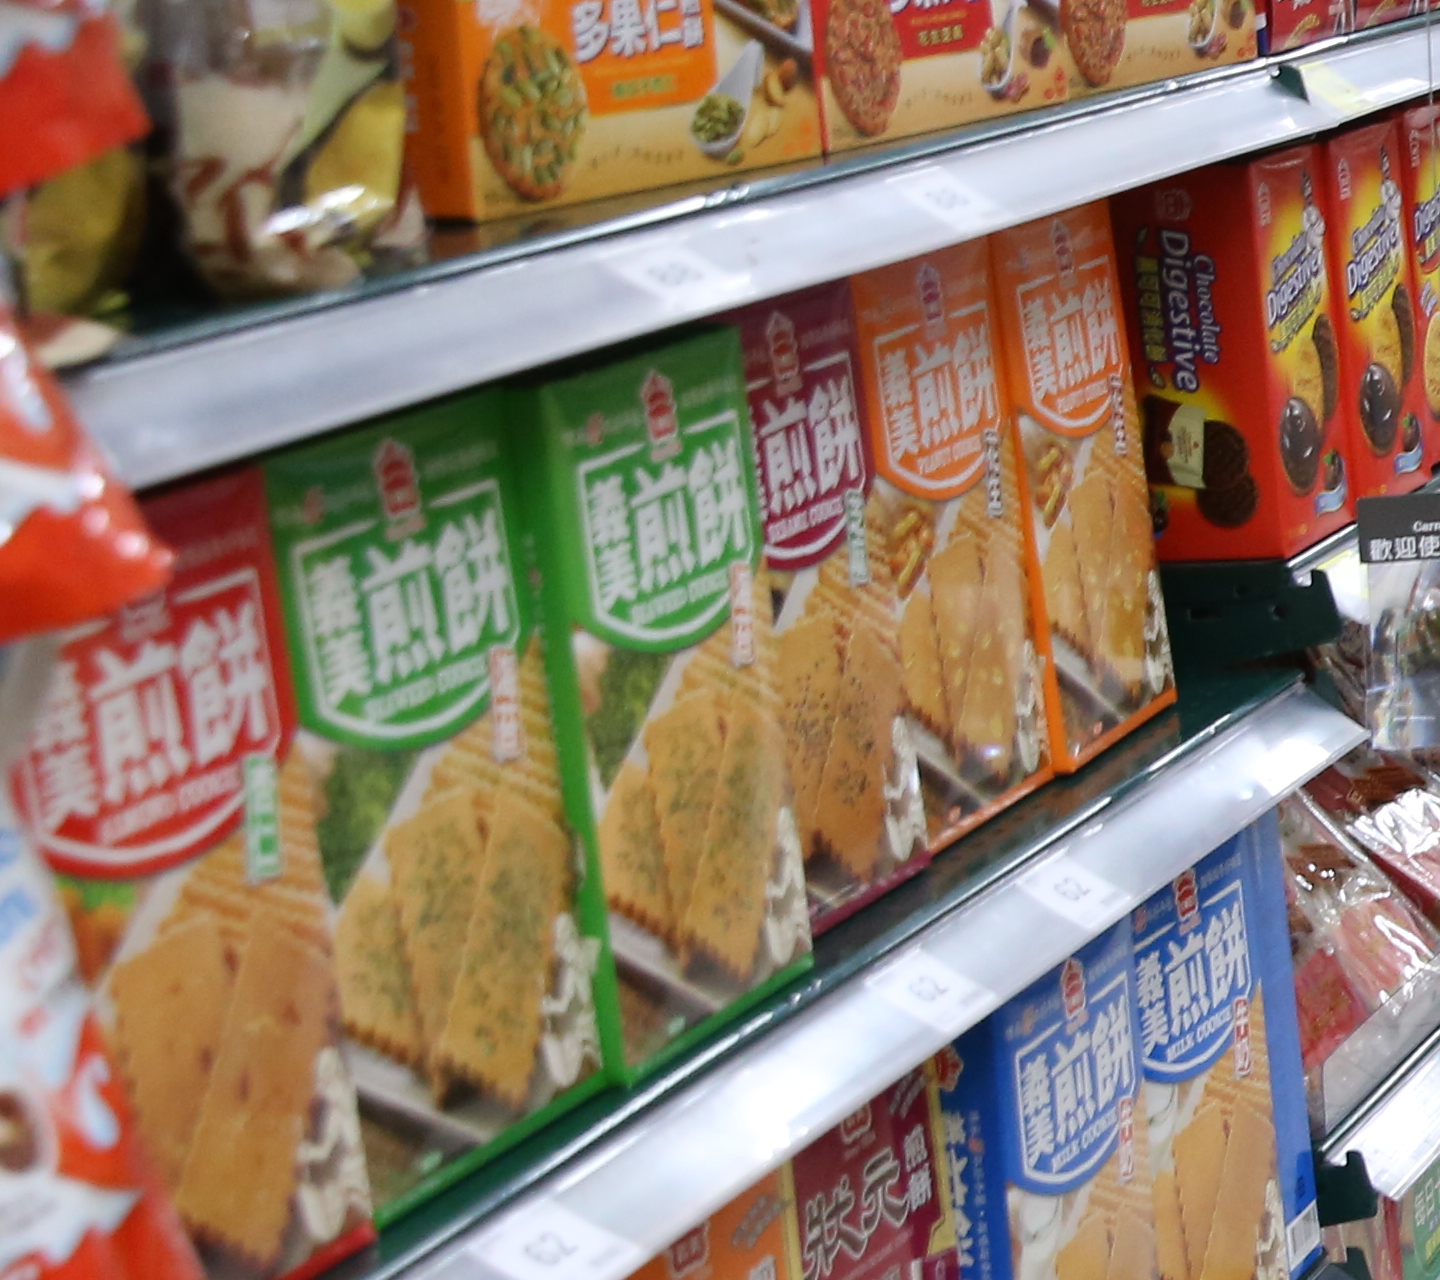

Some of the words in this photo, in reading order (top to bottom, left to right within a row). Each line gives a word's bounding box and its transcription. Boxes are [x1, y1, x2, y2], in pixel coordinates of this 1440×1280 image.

[1159, 228, 1199, 392] Digestive
[1191, 254, 1220, 364] Chocolate
[1051, 995, 1134, 1144] 煎餅
